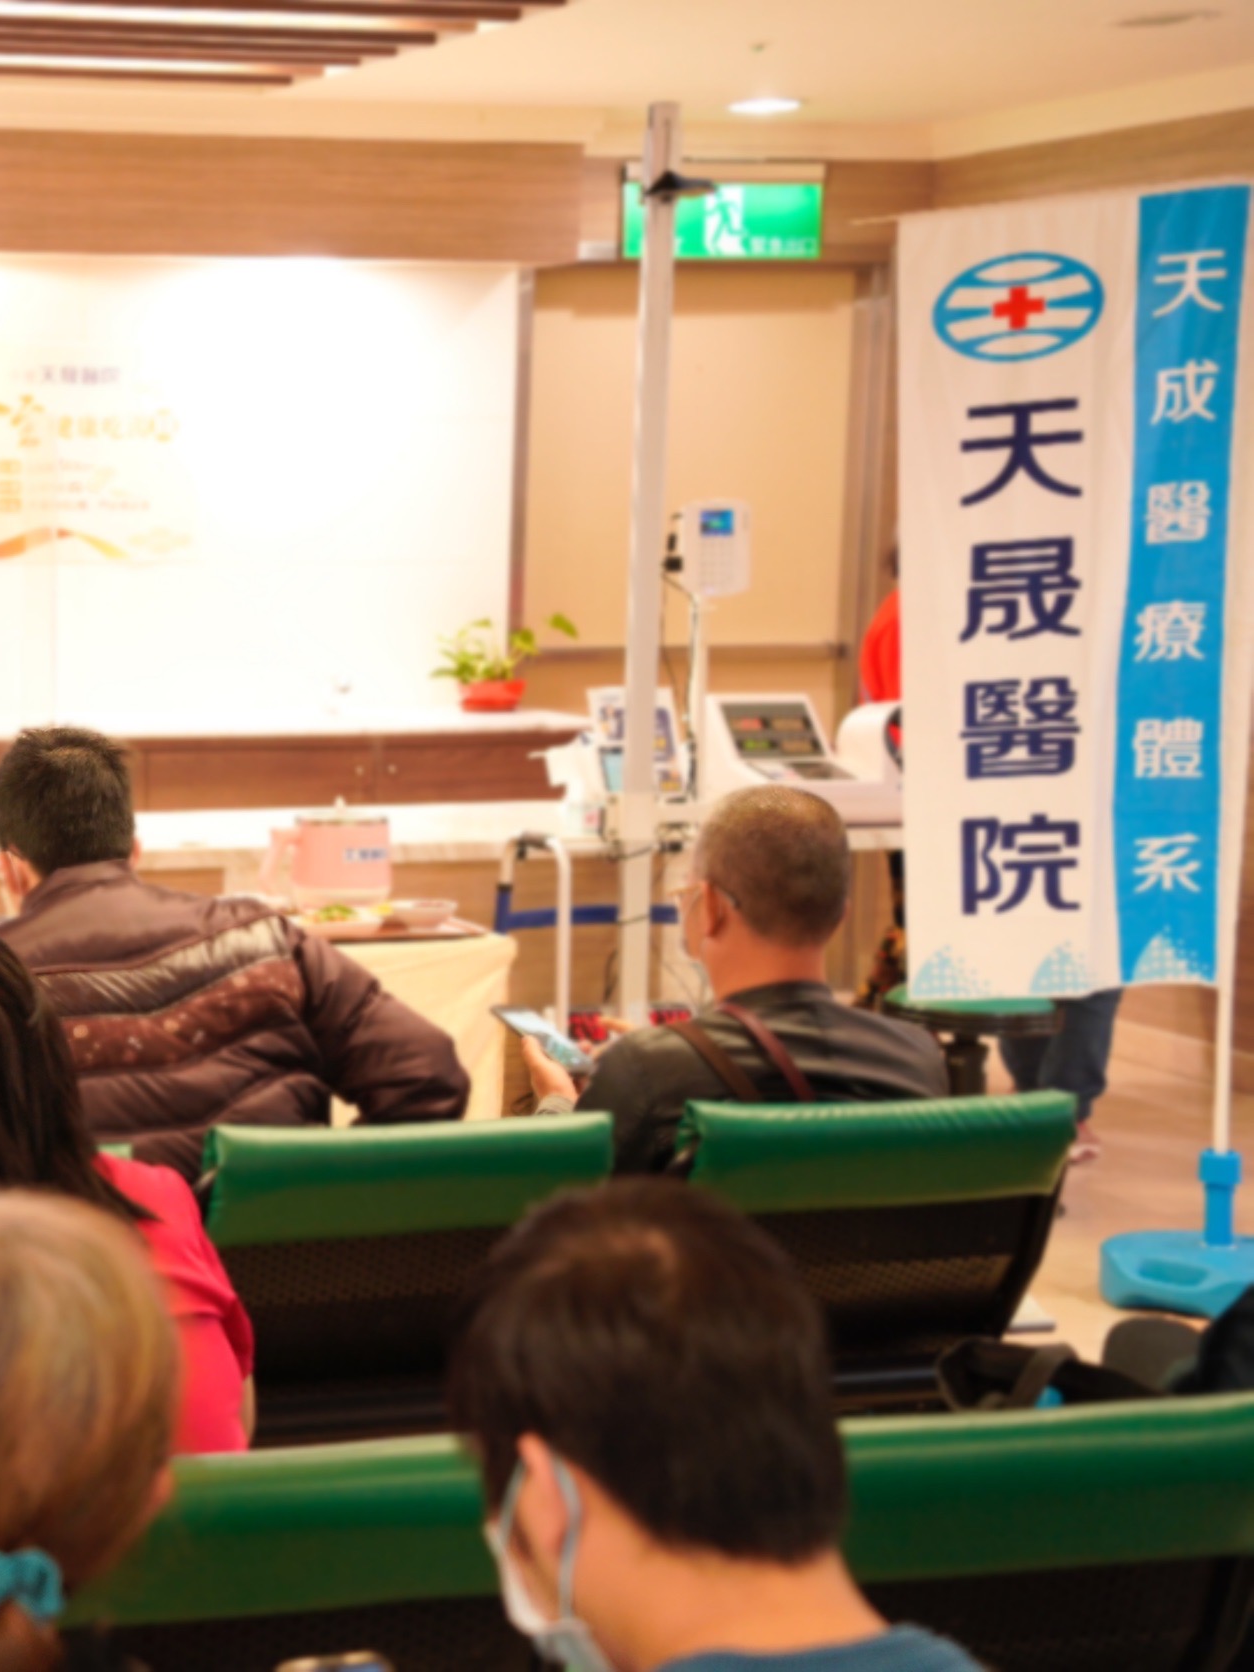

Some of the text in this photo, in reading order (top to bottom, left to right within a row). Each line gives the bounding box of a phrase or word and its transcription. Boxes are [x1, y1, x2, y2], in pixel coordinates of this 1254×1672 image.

[959, 397, 1084, 916] 天晟醫院
[1133, 249, 1227, 894] 天成醫療體系
